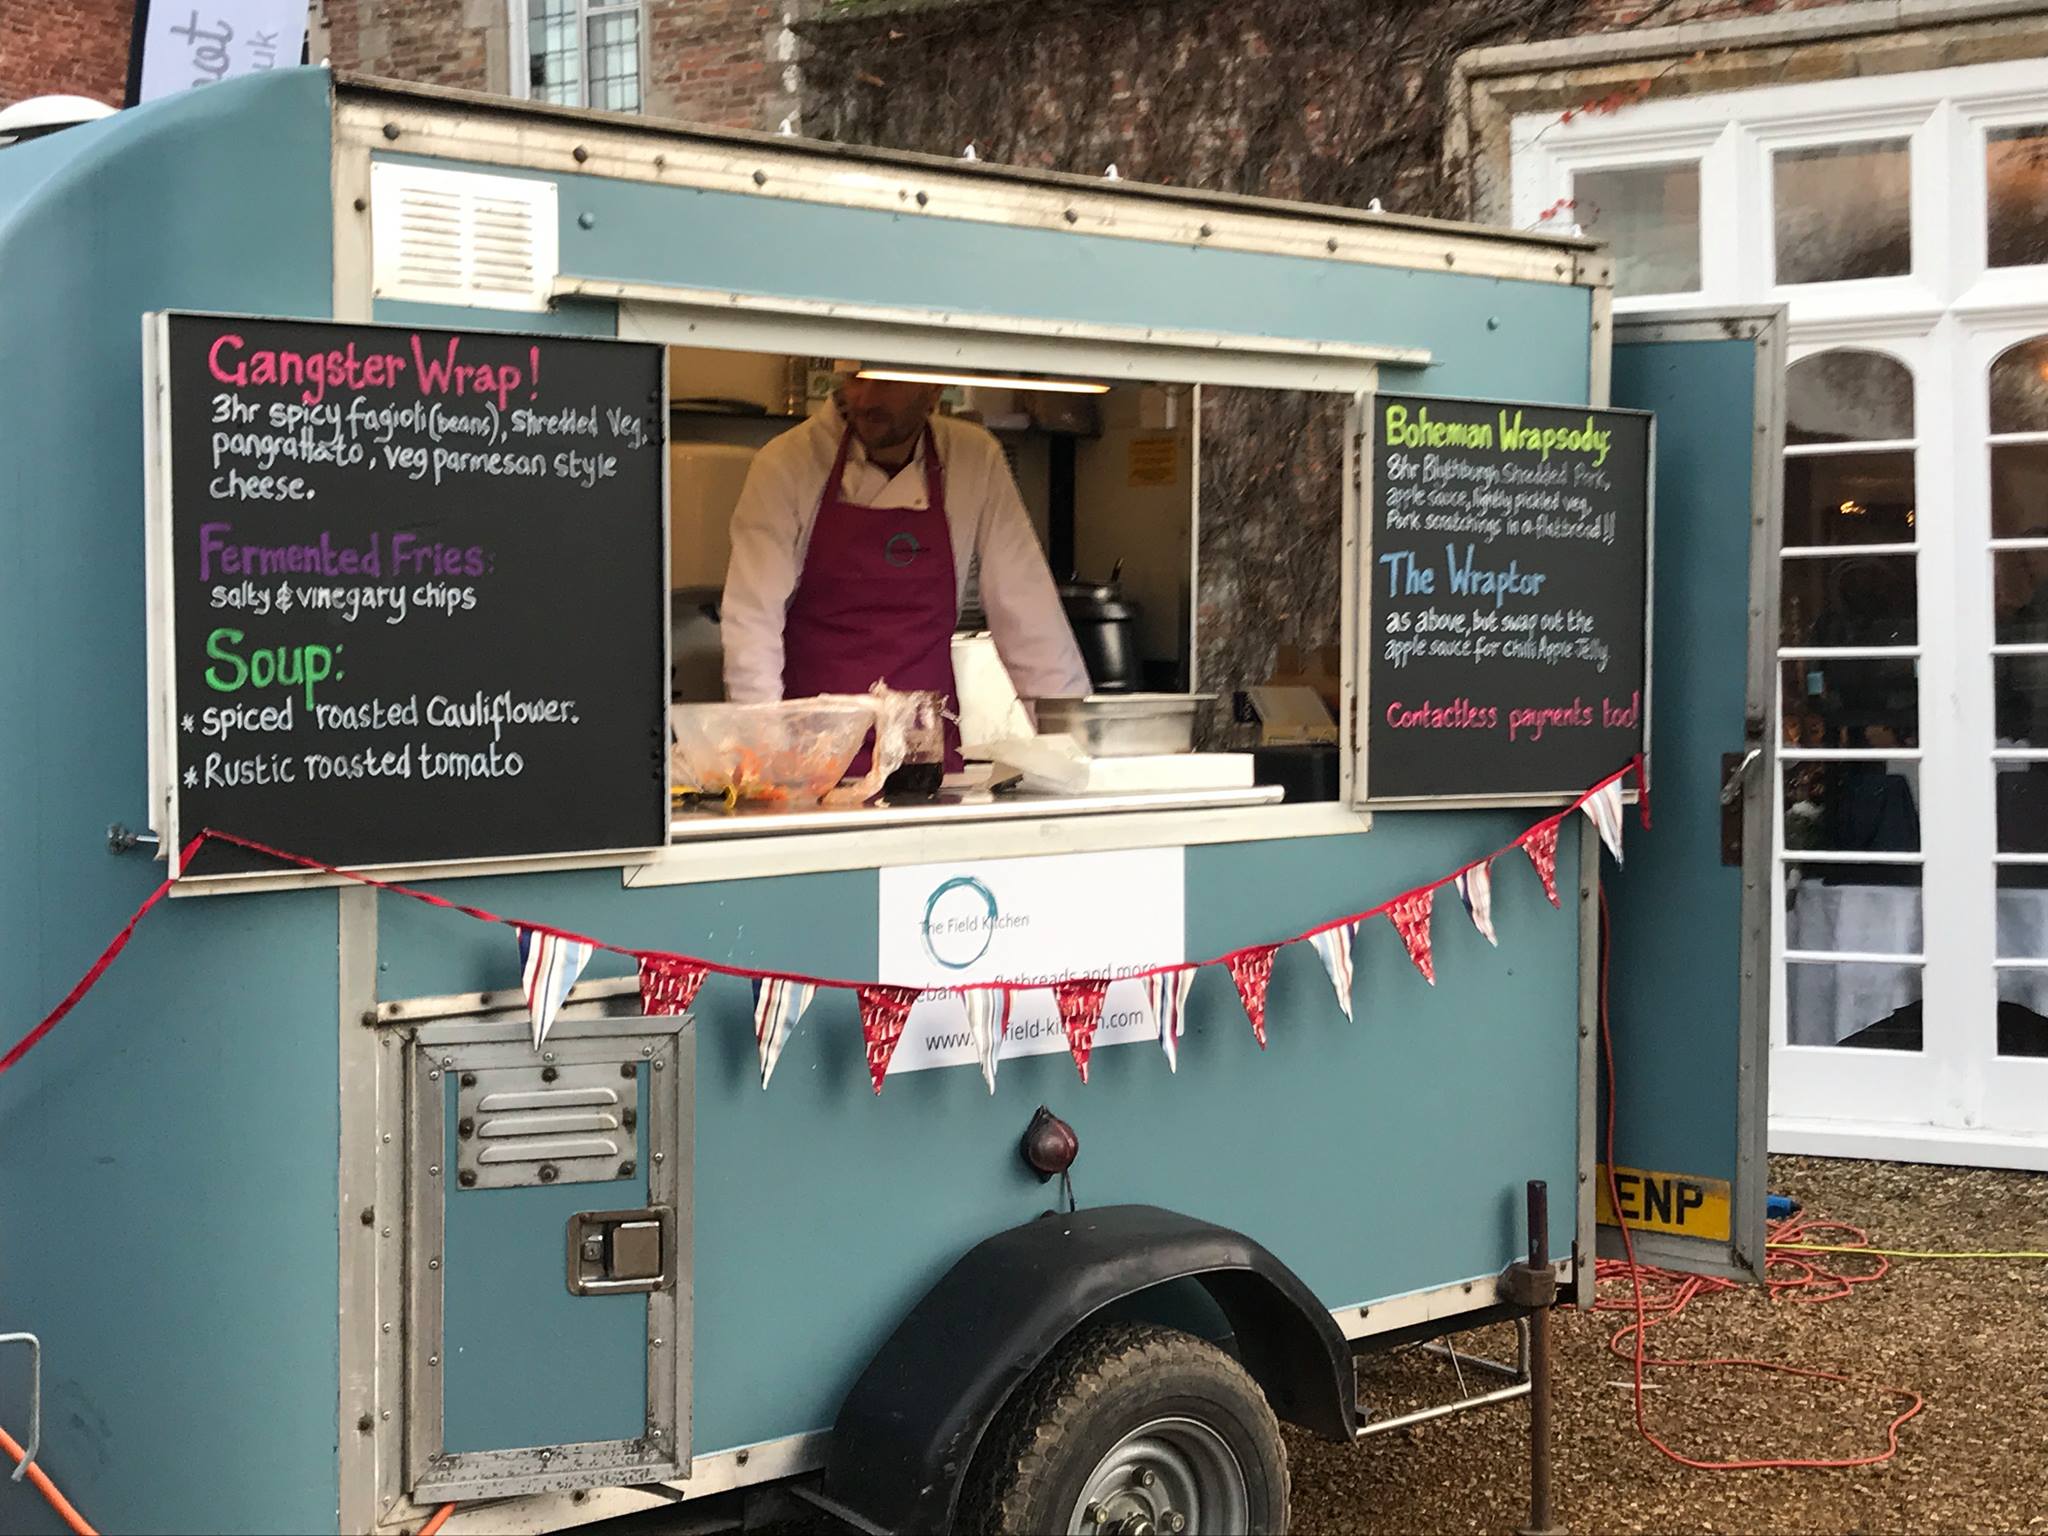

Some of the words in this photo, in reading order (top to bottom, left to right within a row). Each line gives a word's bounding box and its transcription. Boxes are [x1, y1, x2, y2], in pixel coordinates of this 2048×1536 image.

[208, 333, 405, 404] Gangster
[410, 334, 540, 410] Wrap!
[211, 393, 258, 424] 3hr
[268, 400, 342, 445] spicy
[1499, 409, 1611, 468] Wrapsody
[209, 469, 316, 500] cheese.
[433, 447, 547, 486] parmesan
[1386, 452, 1421, 481] 8hr
[200, 521, 380, 581] Fermented
[1379, 551, 1436, 598] The
[1445, 543, 1547, 609] Wraptor
[274, 580, 294, 615] &
[296, 584, 407, 625] vinegary
[412, 581, 477, 616] chips
[1385, 611, 1411, 633] as
[1414, 606, 1471, 638] above,
[1471, 608, 1498, 633] but
[1500, 613, 1539, 641] swap
[1540, 609, 1564, 632] out
[1567, 608, 1594, 634] the
[204, 628, 345, 711] Soup:
[1384, 634, 1426, 669] apple
[1429, 640, 1471, 657] sauce
[1473, 635, 1501, 664] for
[314, 694, 418, 731] roasted
[1386, 697, 1498, 729] Contactless
[1508, 696, 1593, 742] payments
[204, 752, 296, 790] Rustic
[304, 743, 411, 782] roasted
[419, 742, 524, 780] tomato
[918, 920, 944, 935] The
[947, 915, 978, 933] Field
[981, 912, 1030, 930] Kitchen
[1083, 963, 1111, 981] and
[1614, 1173, 1703, 1225] ENP
